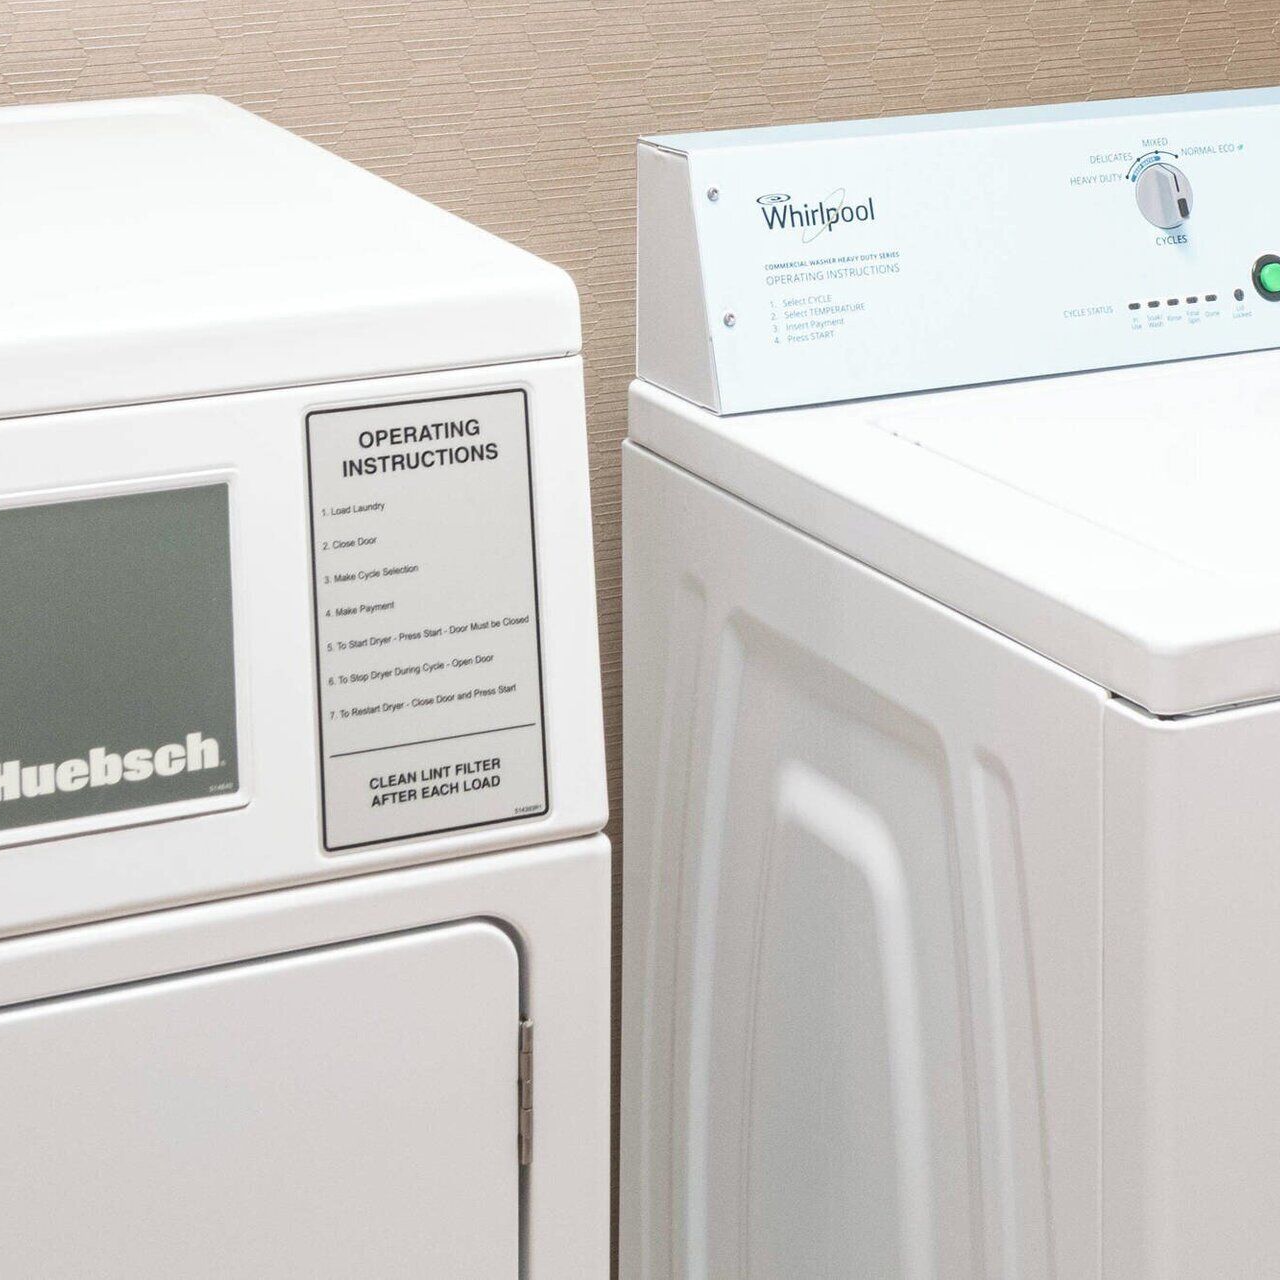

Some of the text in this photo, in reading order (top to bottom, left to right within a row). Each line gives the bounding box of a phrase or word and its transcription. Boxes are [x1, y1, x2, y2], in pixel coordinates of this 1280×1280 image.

[1142, 137, 1169, 147] MIXED
[1181, 143, 1235, 157] NORMAL ECO
[1089, 152, 1133, 164] DELICATES
[1069, 173, 1122, 185] HEAVY DUTY
[761, 197, 875, 232] Whirlpool
[1155, 235, 1188, 246] CYCLES
[765, 251, 900, 271] COMMERCIAL WASHER HEAVY DUTY SERIES
[766, 263, 901, 286] OPERATING INSTRUCTIONS
[783, 297, 807, 308] Select
[807, 294, 833, 304] CYCLE
[784, 309, 808, 319] Select
[809, 303, 865, 317] TEMPERATURE
[1063, 305, 1114, 318] CYCLE STATUS
[786, 321, 809, 331] Insert
[810, 318, 844, 329] Payment
[787, 334, 810, 343] Press
[810, 330, 835, 341] START
[359, 419, 480, 448] OPERATING
[342, 443, 499, 477] INSTRUCTIONS
[331, 506, 351, 516] Load
[353, 502, 385, 513] Laundry
[332, 540, 355, 549] Close
[357, 536, 377, 546] Door
[334, 573, 356, 583] Make
[358, 570, 380, 581] Cycle
[382, 564, 419, 577] Selection
[335, 607, 358, 617] Make
[359, 601, 395, 614] Payment
[337, 641, 347, 650] To
[349, 639, 368, 649] Start
[369, 636, 392, 647] Dryer
[399, 632, 422, 642] Press
[423, 628, 442, 638] Start
[449, 624, 469, 634] Door
[470, 621, 489, 631] Must
[491, 620, 501, 628] be
[502, 614, 530, 626] Closed
[338, 675, 348, 684] To
[349, 673, 369, 683] Stop
[370, 670, 393, 680] Dryer
[394, 665, 421, 675] During
[422, 662, 445, 673] Cycle
[451, 657, 473, 668] Open
[475, 654, 495, 664] Door
[339, 709, 350, 719] To
[351, 705, 381, 717] Restart
[382, 701, 404, 713] Dryer
[411, 697, 435, 708] Close
[436, 694, 455, 704] Door
[457, 689, 472, 700] and
[473, 687, 496, 697] Press
[498, 683, 517, 694] Start
[369, 758, 501, 790] CLEAN LINT FILTER
[371, 775, 501, 808] AFTER EACH LOAD
